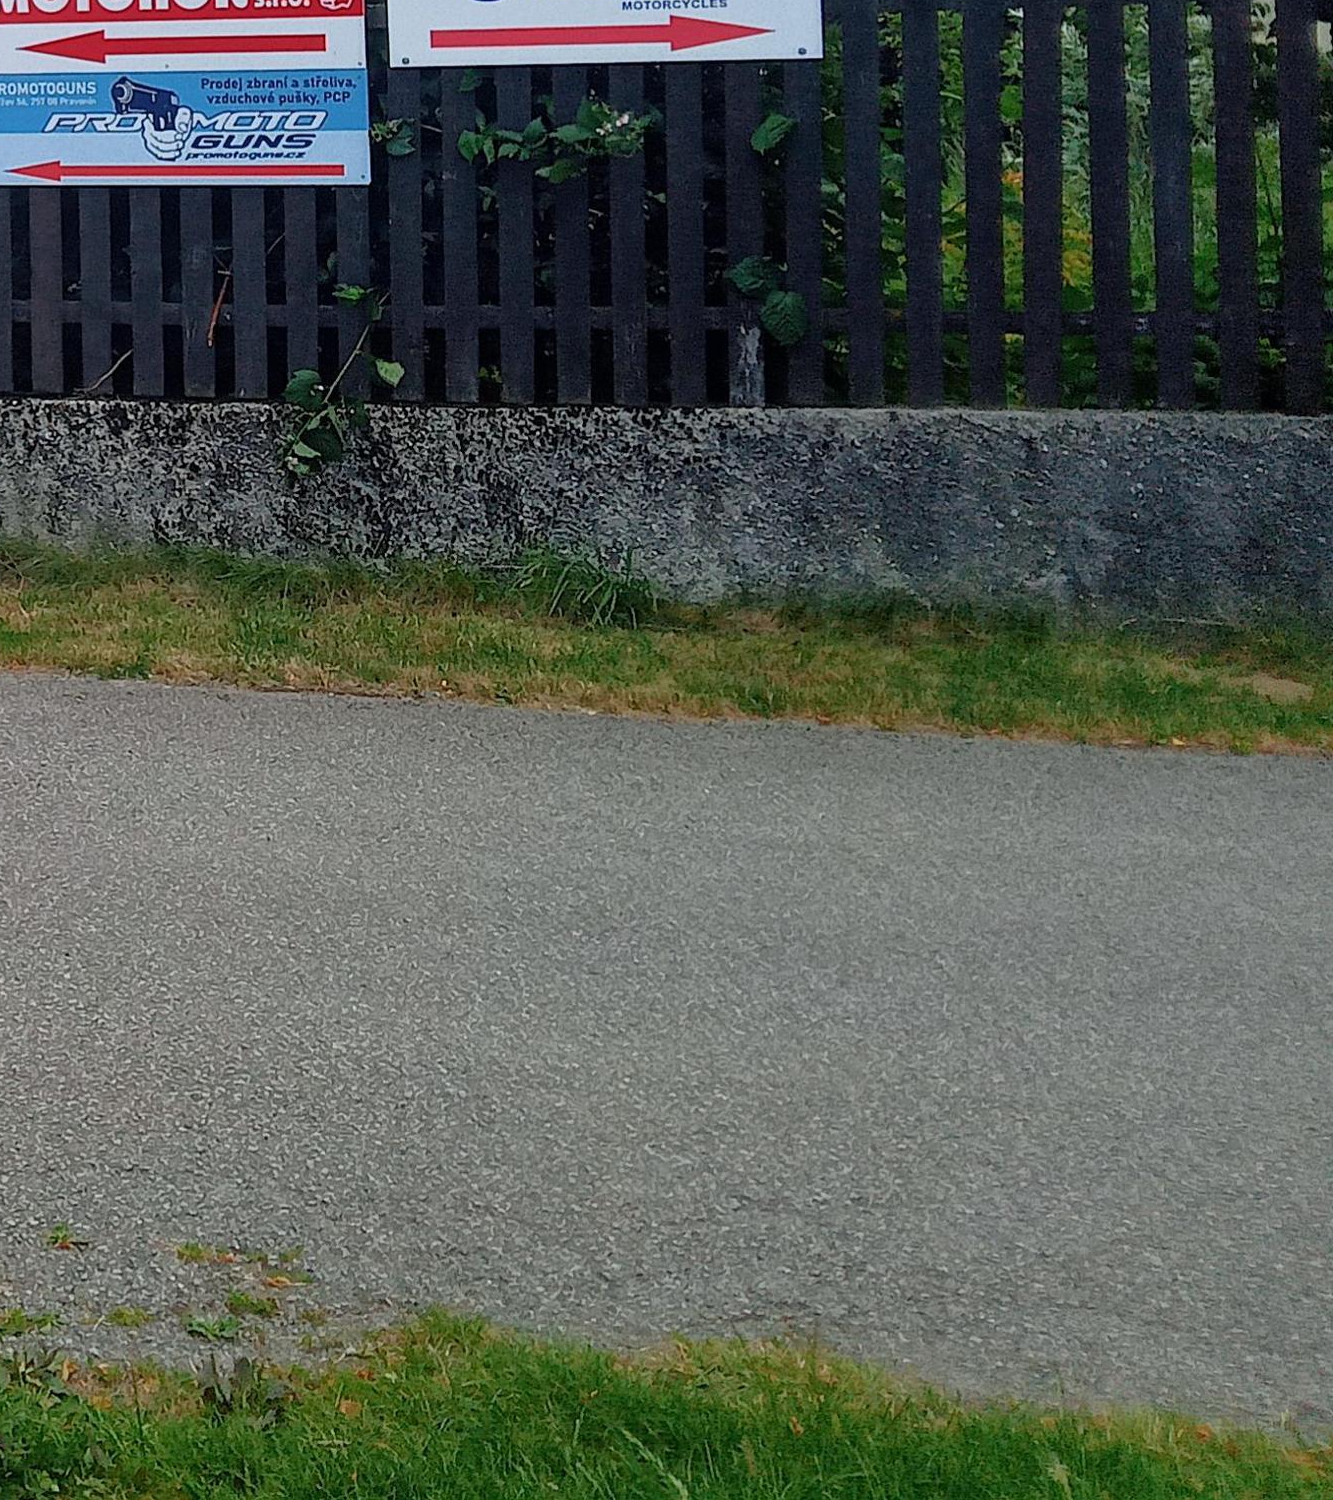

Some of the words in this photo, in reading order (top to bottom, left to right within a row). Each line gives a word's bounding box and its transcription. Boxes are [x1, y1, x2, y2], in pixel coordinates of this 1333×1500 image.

[201, 78, 243, 92] Prodej
[246, 76, 287, 88] zbraní
[290, 78, 300, 88] a
[206, 93, 276, 105] vzduchové
[279, 90, 321, 107] pušky,
[323, 91, 352, 104] PCP
[43, 111, 145, 133] PRO
[192, 110, 328, 132] MOTO
[190, 133, 317, 149] GUNS
[185, 151, 307, 161] promotoguns.cz
